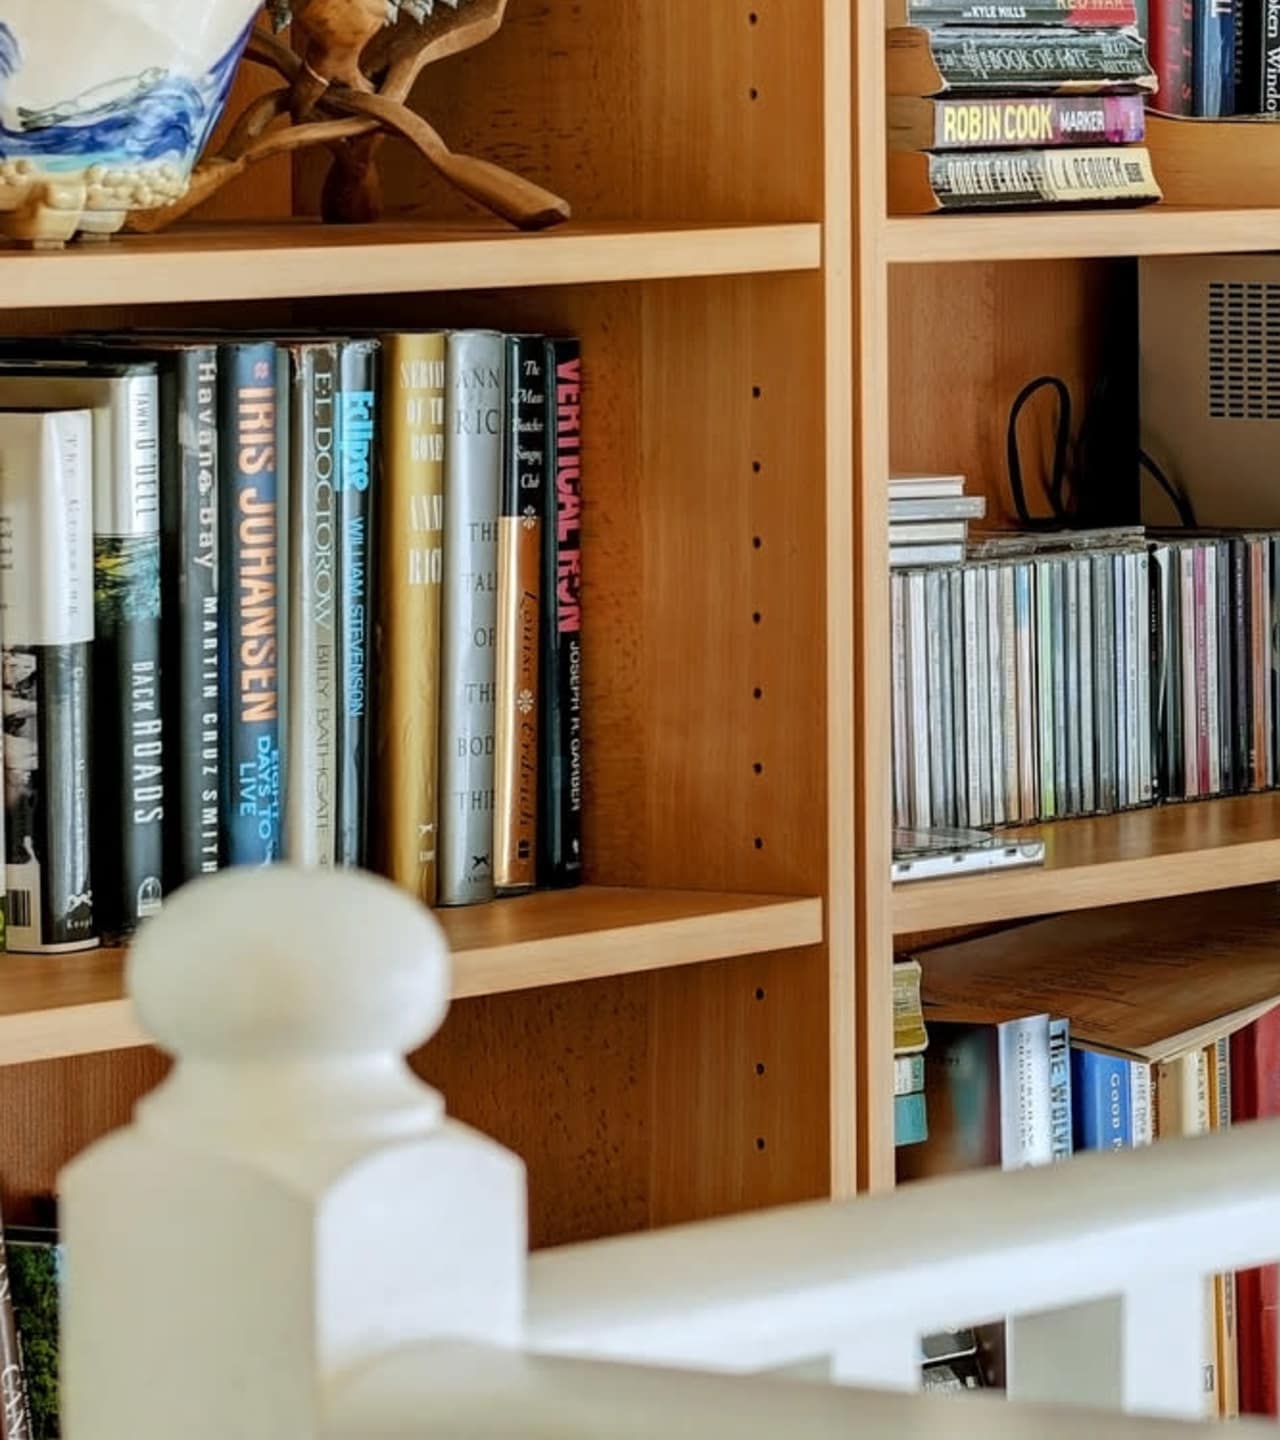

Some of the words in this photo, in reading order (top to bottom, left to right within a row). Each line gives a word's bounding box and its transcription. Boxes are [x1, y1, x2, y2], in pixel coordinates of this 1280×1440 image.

[971, 5, 997, 18] KYLE
[996, 5, 1027, 18] MILLS
[987, 48, 1034, 72] BOOK
[943, 104, 1001, 143] ROBIN
[1003, 103, 1054, 141] COOK
[1059, 110, 1105, 132] MARKER
[135, 390, 153, 433] TAWNI
[197, 361, 217, 496] Havana
[238, 387, 277, 475] IRIS
[340, 389, 375, 493] Eclipse
[556, 358, 581, 542] VERTICAL
[192, 506, 216, 570] Bay
[313, 426, 333, 631] DOCTOROW
[349, 516, 365, 598] WILLIAM
[238, 486, 278, 723] JOHANSEN
[556, 548, 581, 634] RUN
[202, 596, 219, 699] MARTIN
[315, 643, 331, 698] BILLY
[349, 602, 366, 718] STEVENSON
[132, 660, 156, 713] BACK
[133, 718, 164, 825] ROADS
[202, 712, 219, 776] CRUZ
[257, 735, 272, 797] DAYS
[315, 708, 332, 835] BATHGATE
[239, 762, 257, 817] LIVE
[257, 800, 272, 841] TO
[201, 789, 219, 874] SMITH
[1056, 1027, 1075, 1072] THE
[1113, 1068, 1125, 1122] GOOD
